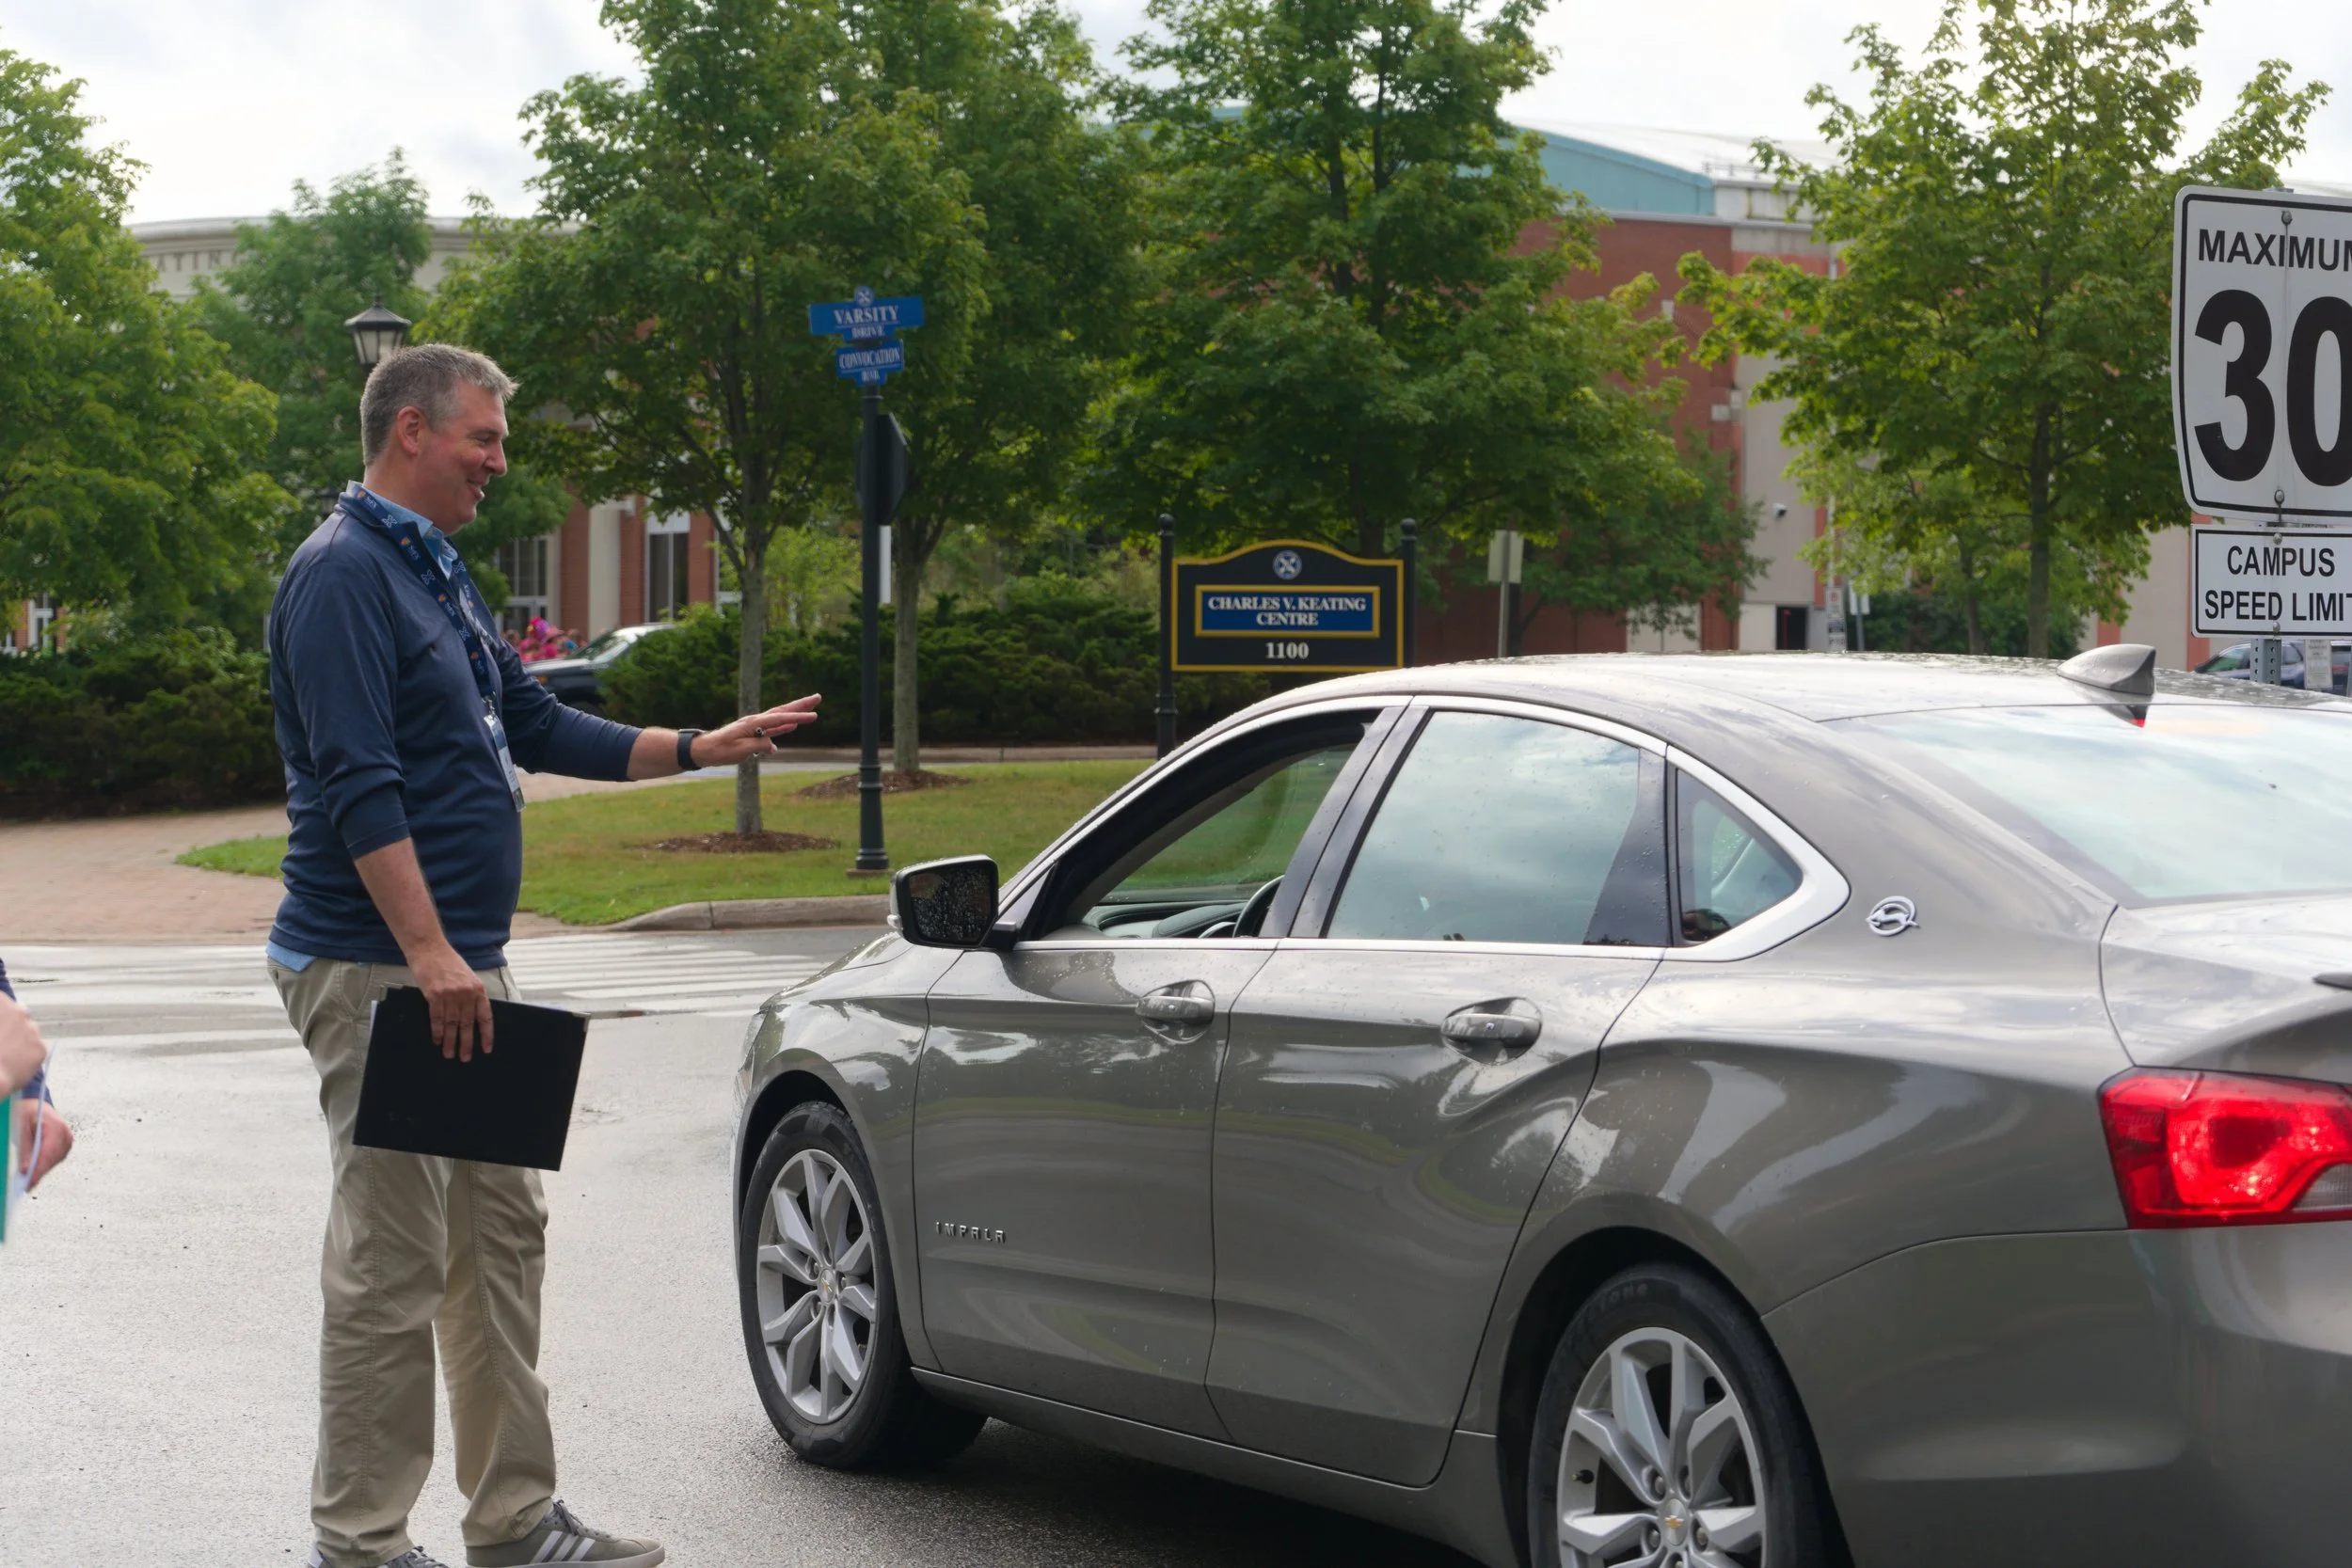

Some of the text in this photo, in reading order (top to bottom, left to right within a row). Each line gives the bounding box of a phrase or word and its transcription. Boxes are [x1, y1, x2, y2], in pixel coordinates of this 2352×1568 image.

[834, 305, 898, 325] VARSITY
[850, 325, 885, 340] DRIVE
[838, 347, 900, 370] CONVOCATION
[2194, 289, 2352, 487] 30
[2227, 545, 2336, 578] CAMPUS
[1207, 596, 1366, 611] CHARLES V. KEATING
[2204, 589, 2283, 621] SPEED
[1255, 612, 1319, 626] CENTRE
[1264, 641, 1310, 659] 1100
[935, 1221, 1006, 1243] IMPALA
